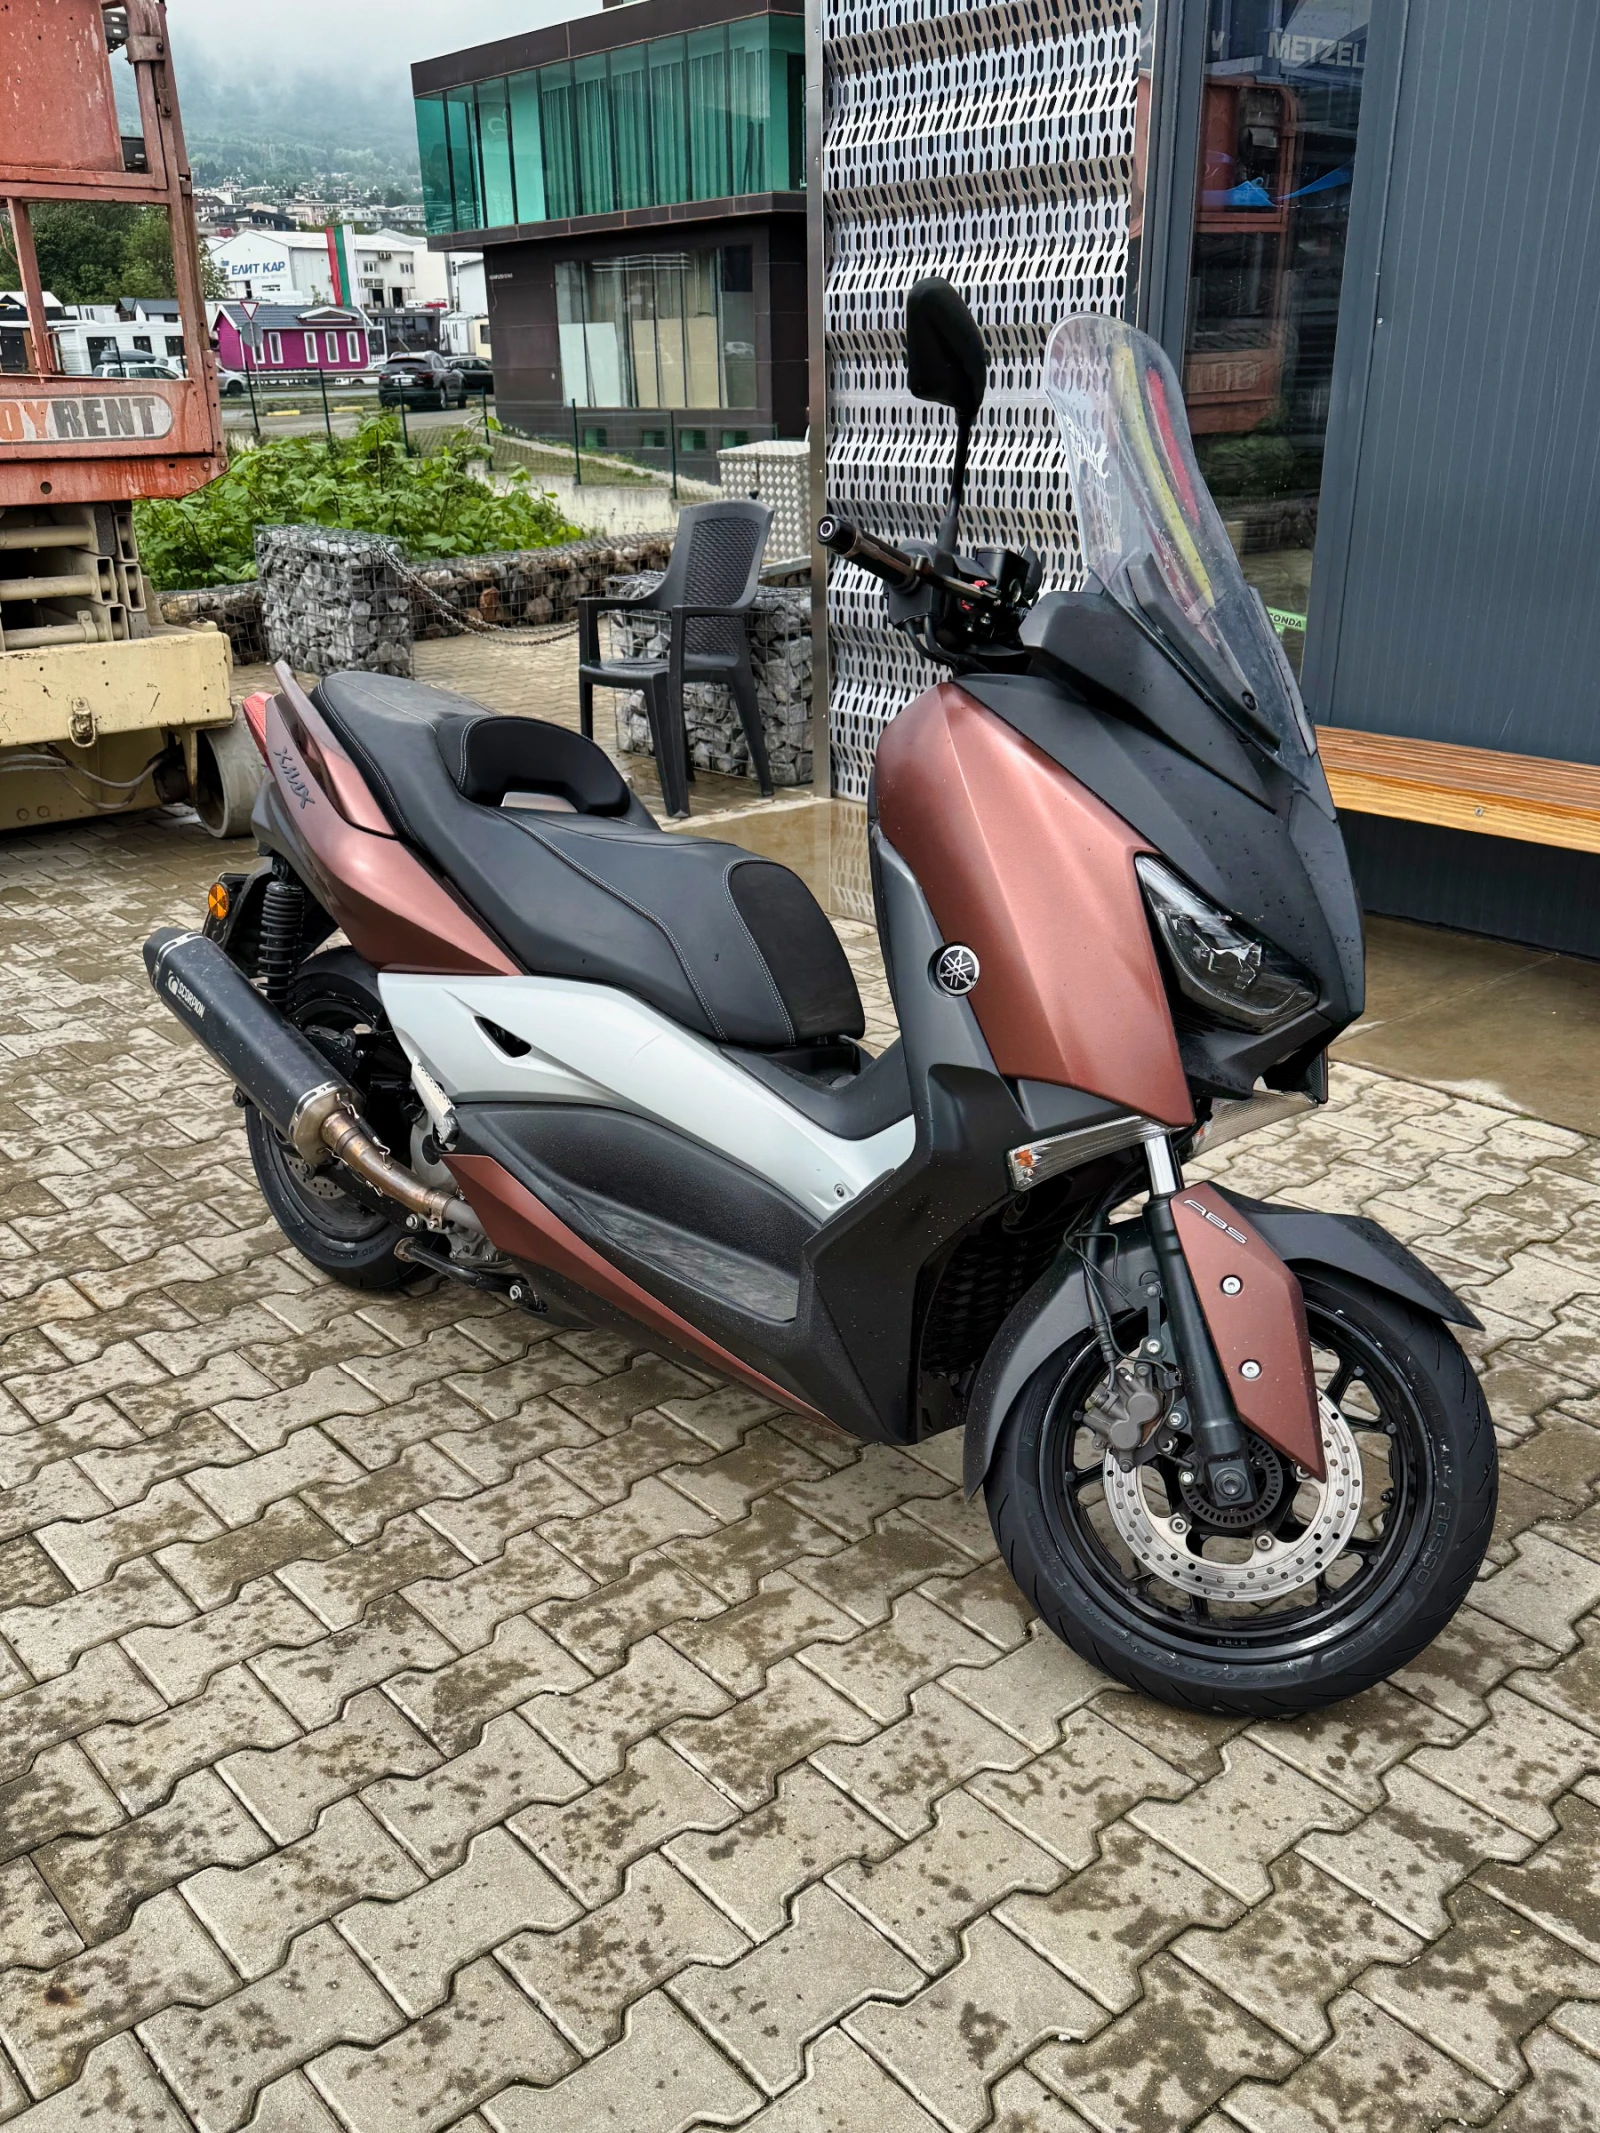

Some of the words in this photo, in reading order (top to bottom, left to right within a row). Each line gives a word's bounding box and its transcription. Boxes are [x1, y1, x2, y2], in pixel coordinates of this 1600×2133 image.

[1268, 31, 1366, 67] METZEL
[231, 263, 260, 275] ЕЛИТ
[262, 261, 286, 273] КАР
[178, 981, 205, 1019] SCORPION
[1184, 1199, 1248, 1244] ABS
[1415, 1501, 1452, 1585] ROSSO
